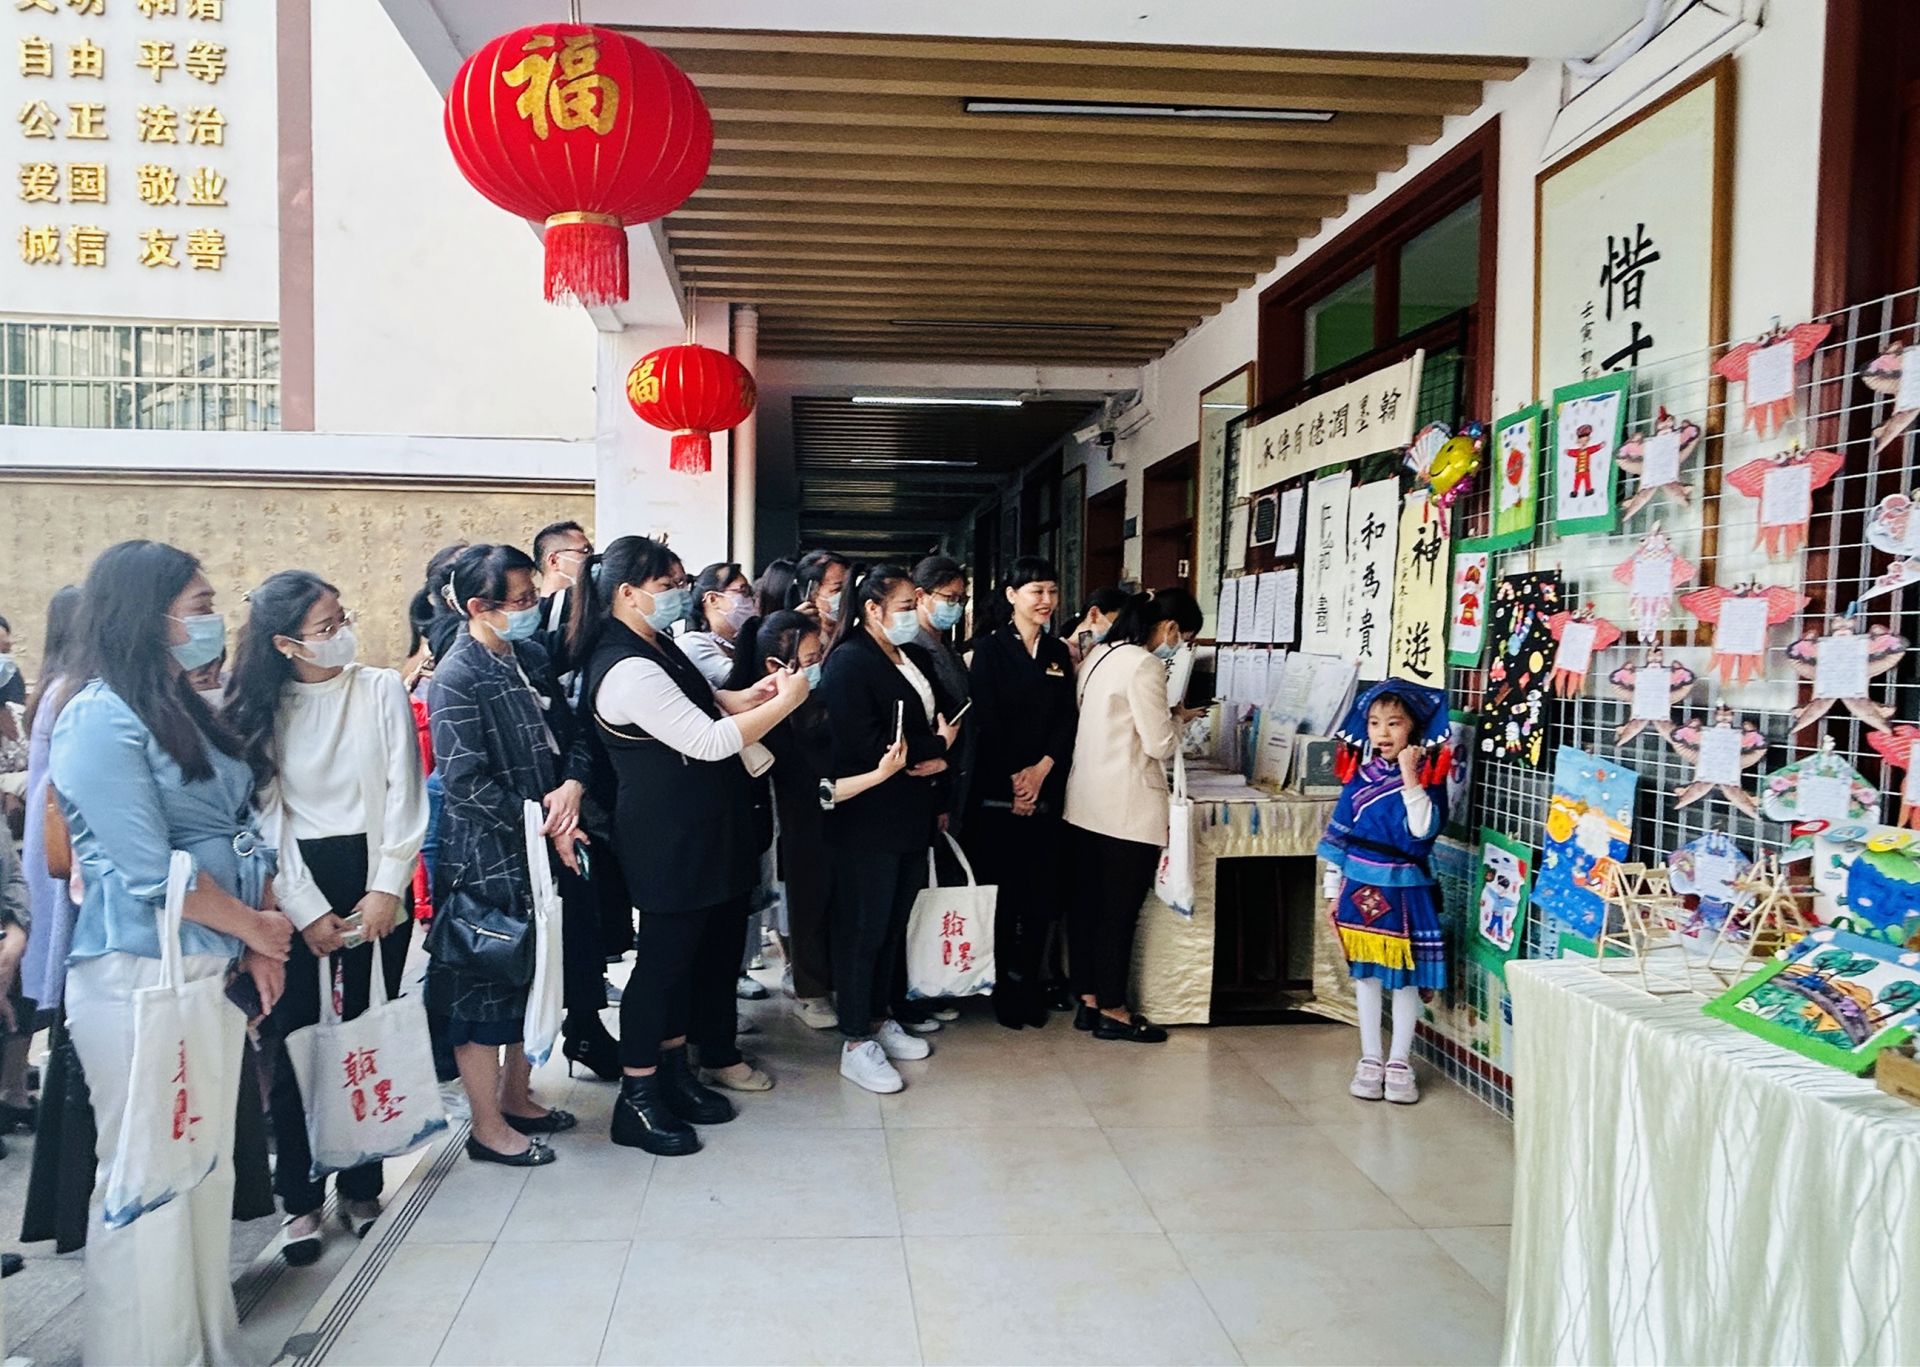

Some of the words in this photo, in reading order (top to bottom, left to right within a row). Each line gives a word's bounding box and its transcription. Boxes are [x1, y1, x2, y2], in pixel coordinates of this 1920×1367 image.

[19, 36, 104, 79] 自由
[137, 40, 227, 83] 平等
[502, 34, 619, 140] 福
[18, 100, 109, 140] 公正
[137, 105, 227, 145] 法治
[19, 163, 108, 204] 爱国
[137, 164, 228, 207] 敬业
[19, 225, 109, 267] 诚信
[137, 228, 228, 270] 友善
[627, 356, 660, 404] 福
